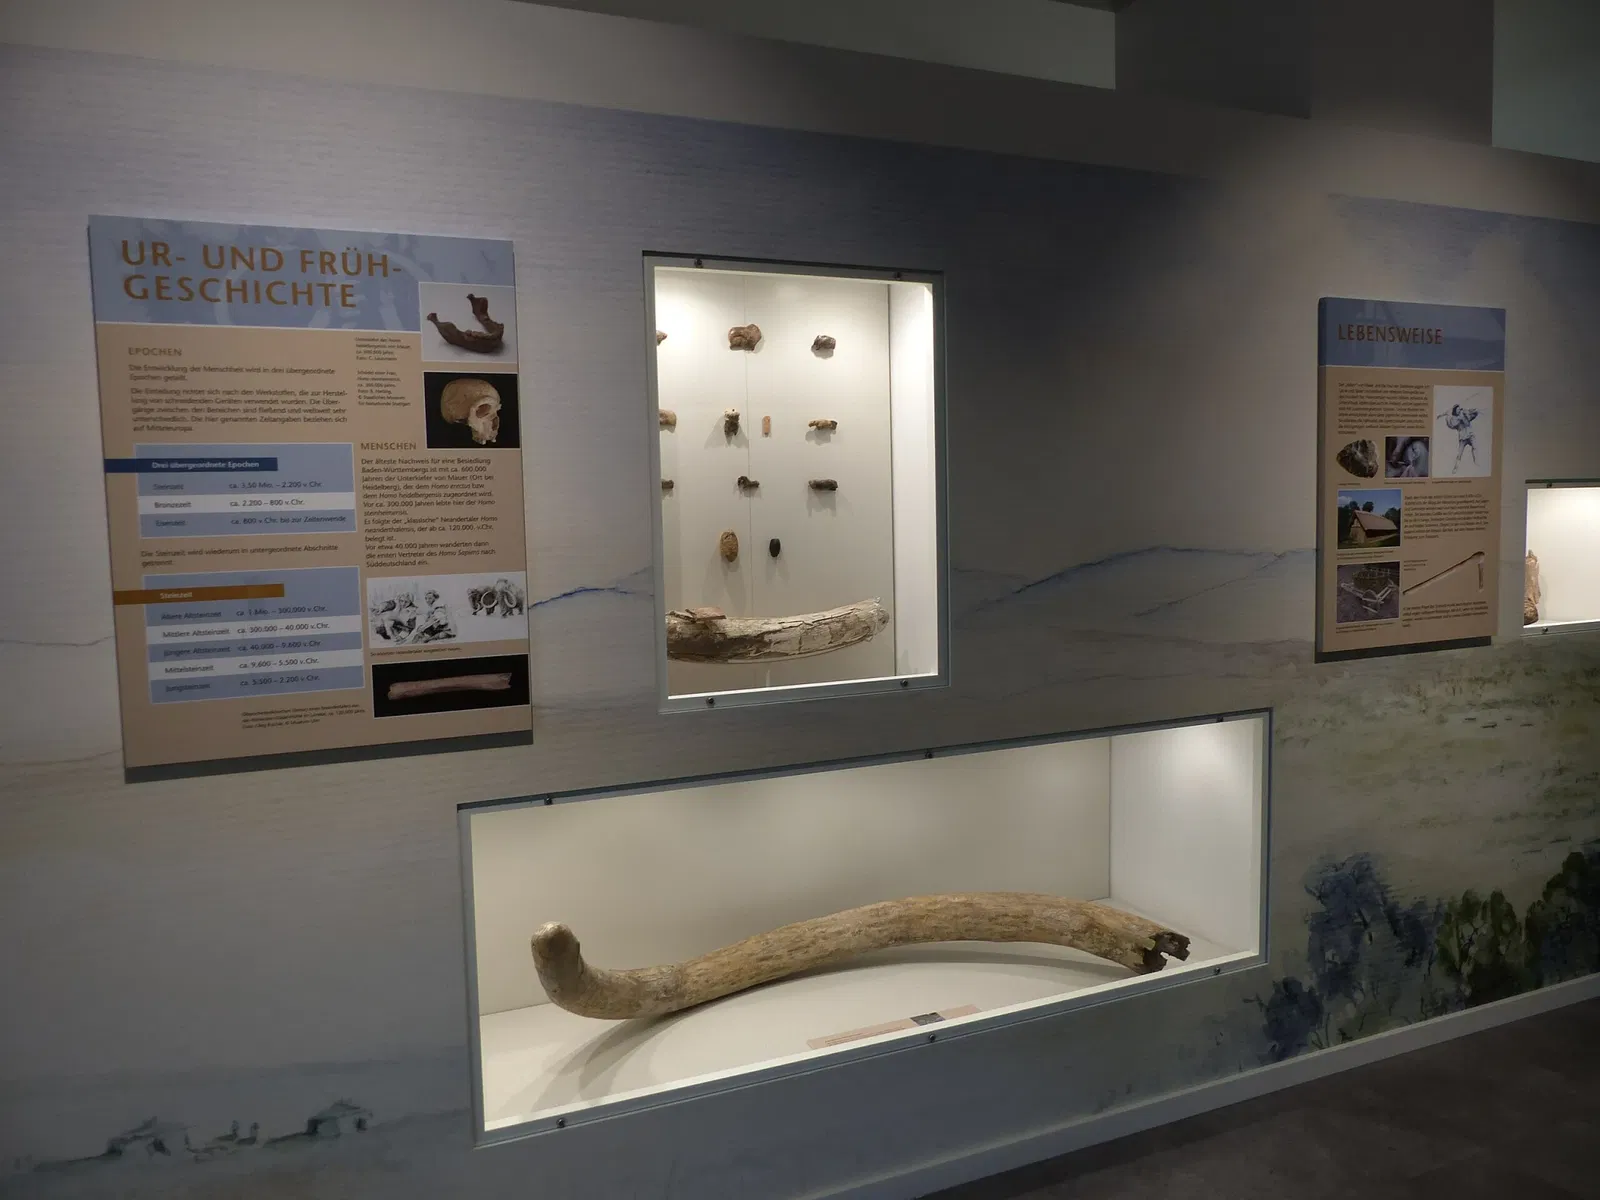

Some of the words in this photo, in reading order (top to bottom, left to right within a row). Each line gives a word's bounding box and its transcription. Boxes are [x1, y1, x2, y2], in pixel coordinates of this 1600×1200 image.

[121, 240, 186, 267] UR-
[202, 244, 284, 272] UND
[300, 247, 402, 278] FRÜH-
[123, 274, 357, 308] GESCHICHTE
[1338, 324, 1443, 344] LEBENSWEISE
[128, 347, 182, 357] EPOCHEN
[361, 442, 416, 450] MENSCHEN
